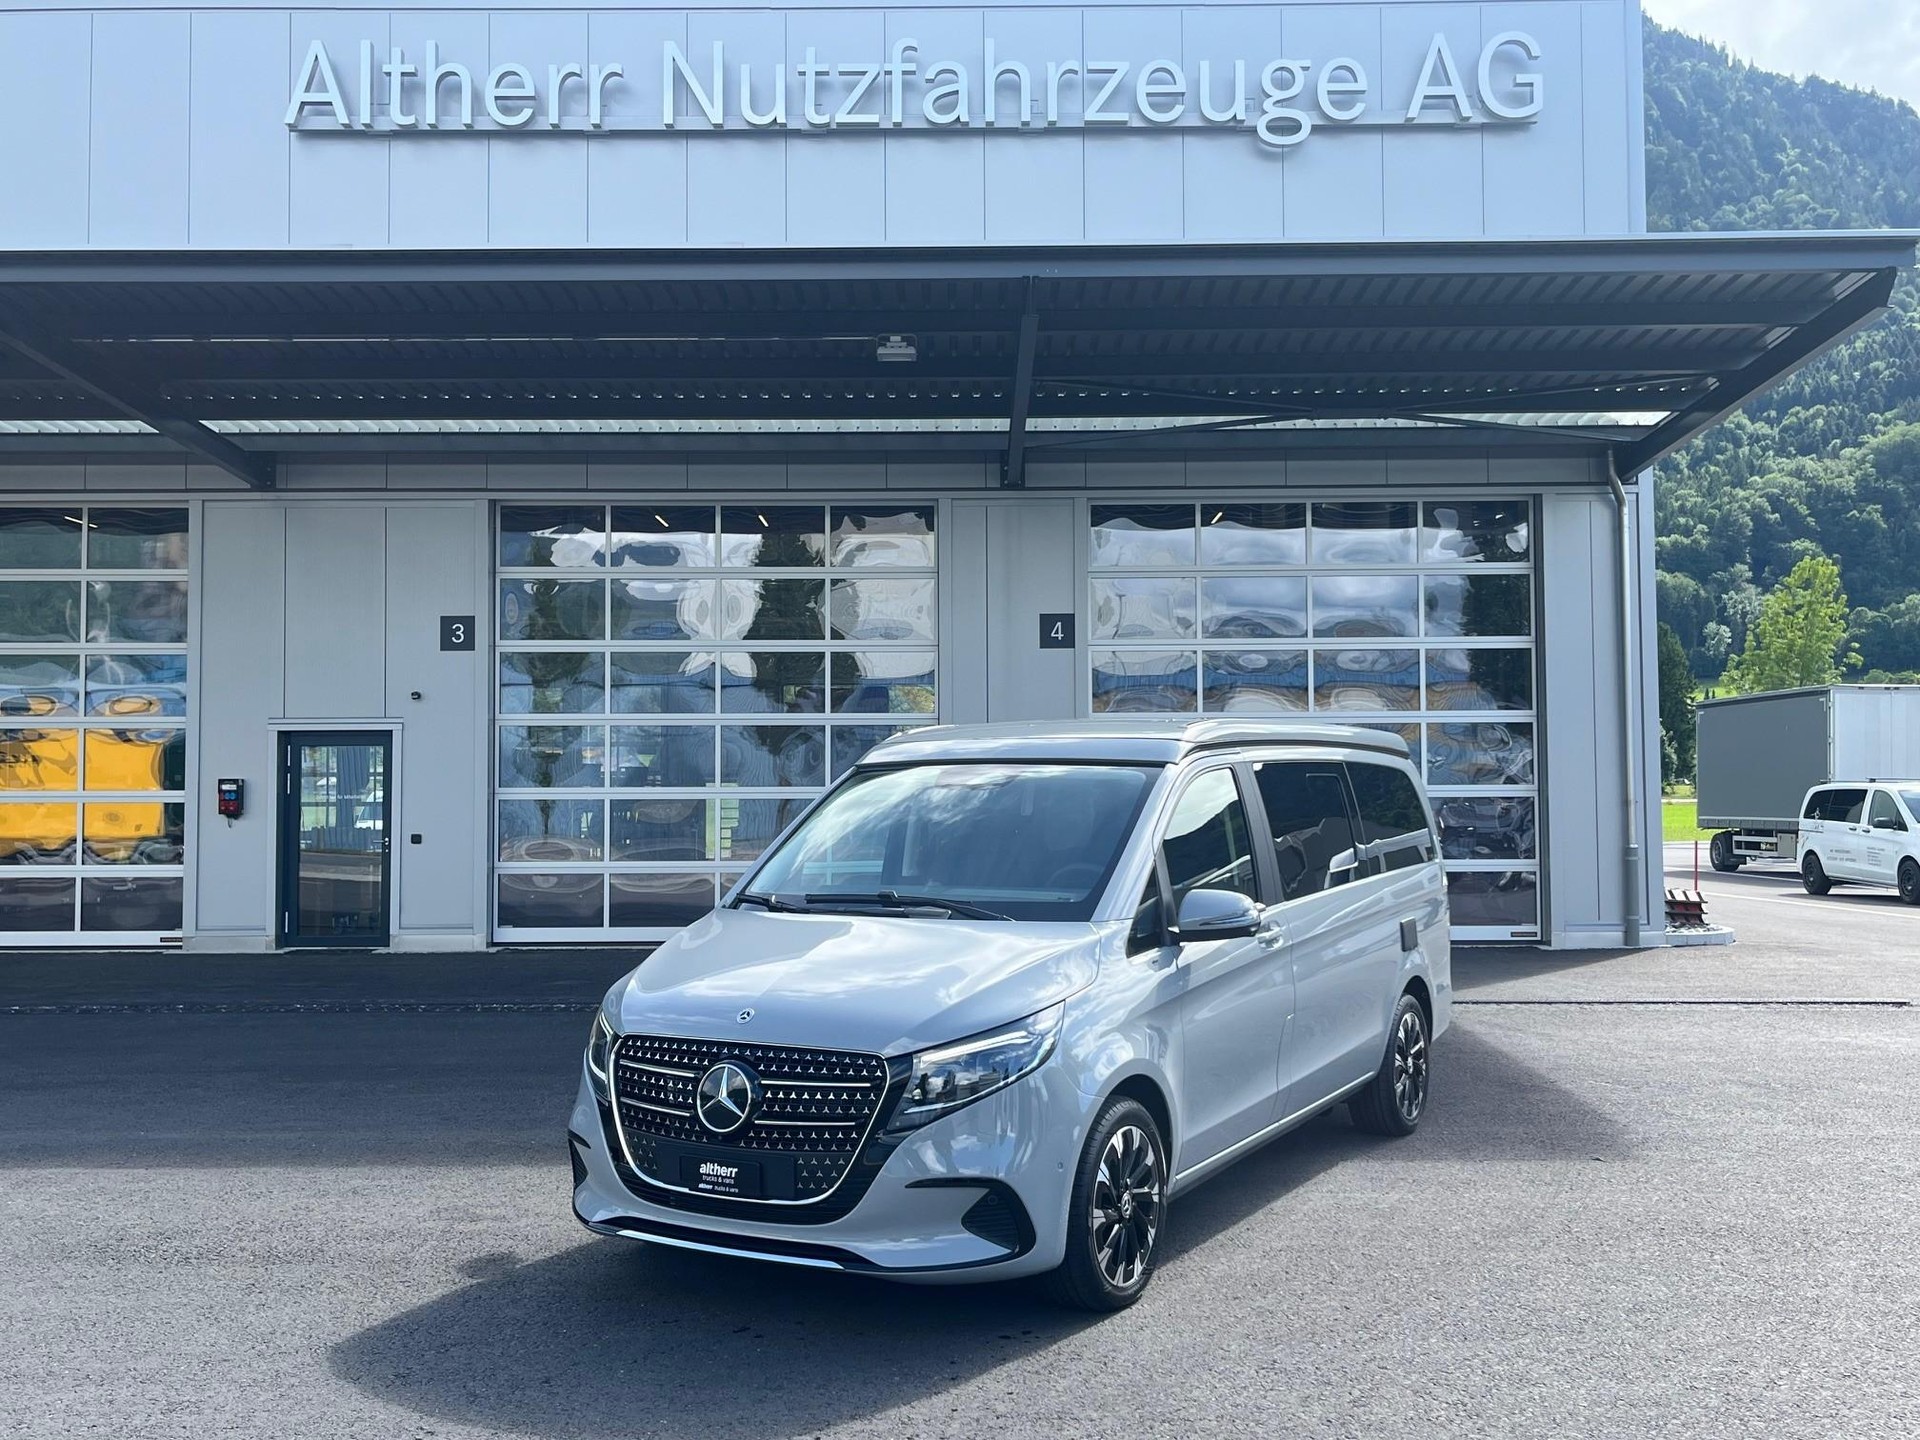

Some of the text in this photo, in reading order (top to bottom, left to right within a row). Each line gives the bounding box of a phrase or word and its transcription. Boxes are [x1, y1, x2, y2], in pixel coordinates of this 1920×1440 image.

[285, 31, 1543, 146] Altherr Nutzfahrzeuge AG
[451, 623, 464, 643] 3
[1050, 621, 1064, 640] 4
[700, 1162, 738, 1178] altherr
